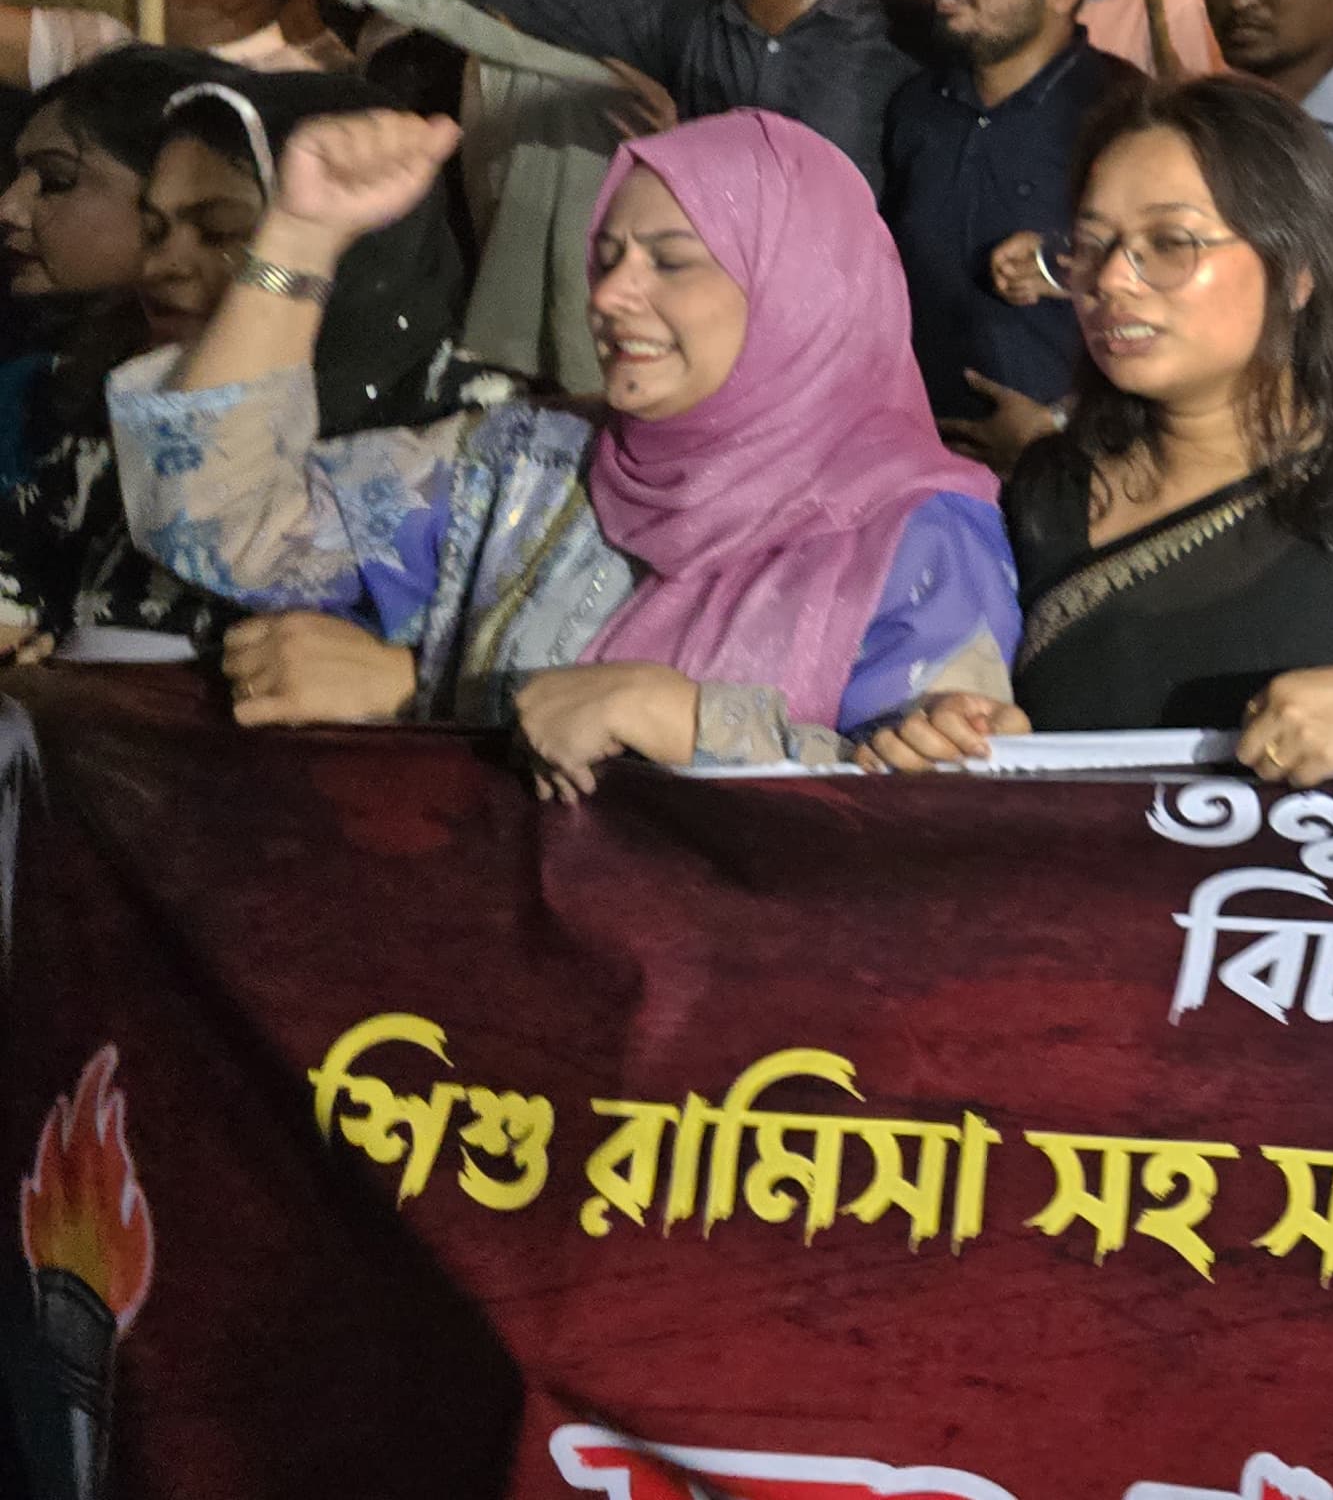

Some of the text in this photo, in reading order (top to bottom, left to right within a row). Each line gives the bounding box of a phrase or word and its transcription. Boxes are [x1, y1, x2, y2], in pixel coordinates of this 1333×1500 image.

[307, 1012, 555, 1212] শিশু
[578, 1048, 1002, 1255] রামিসা
[1023, 1131, 1240, 1283] সহ
